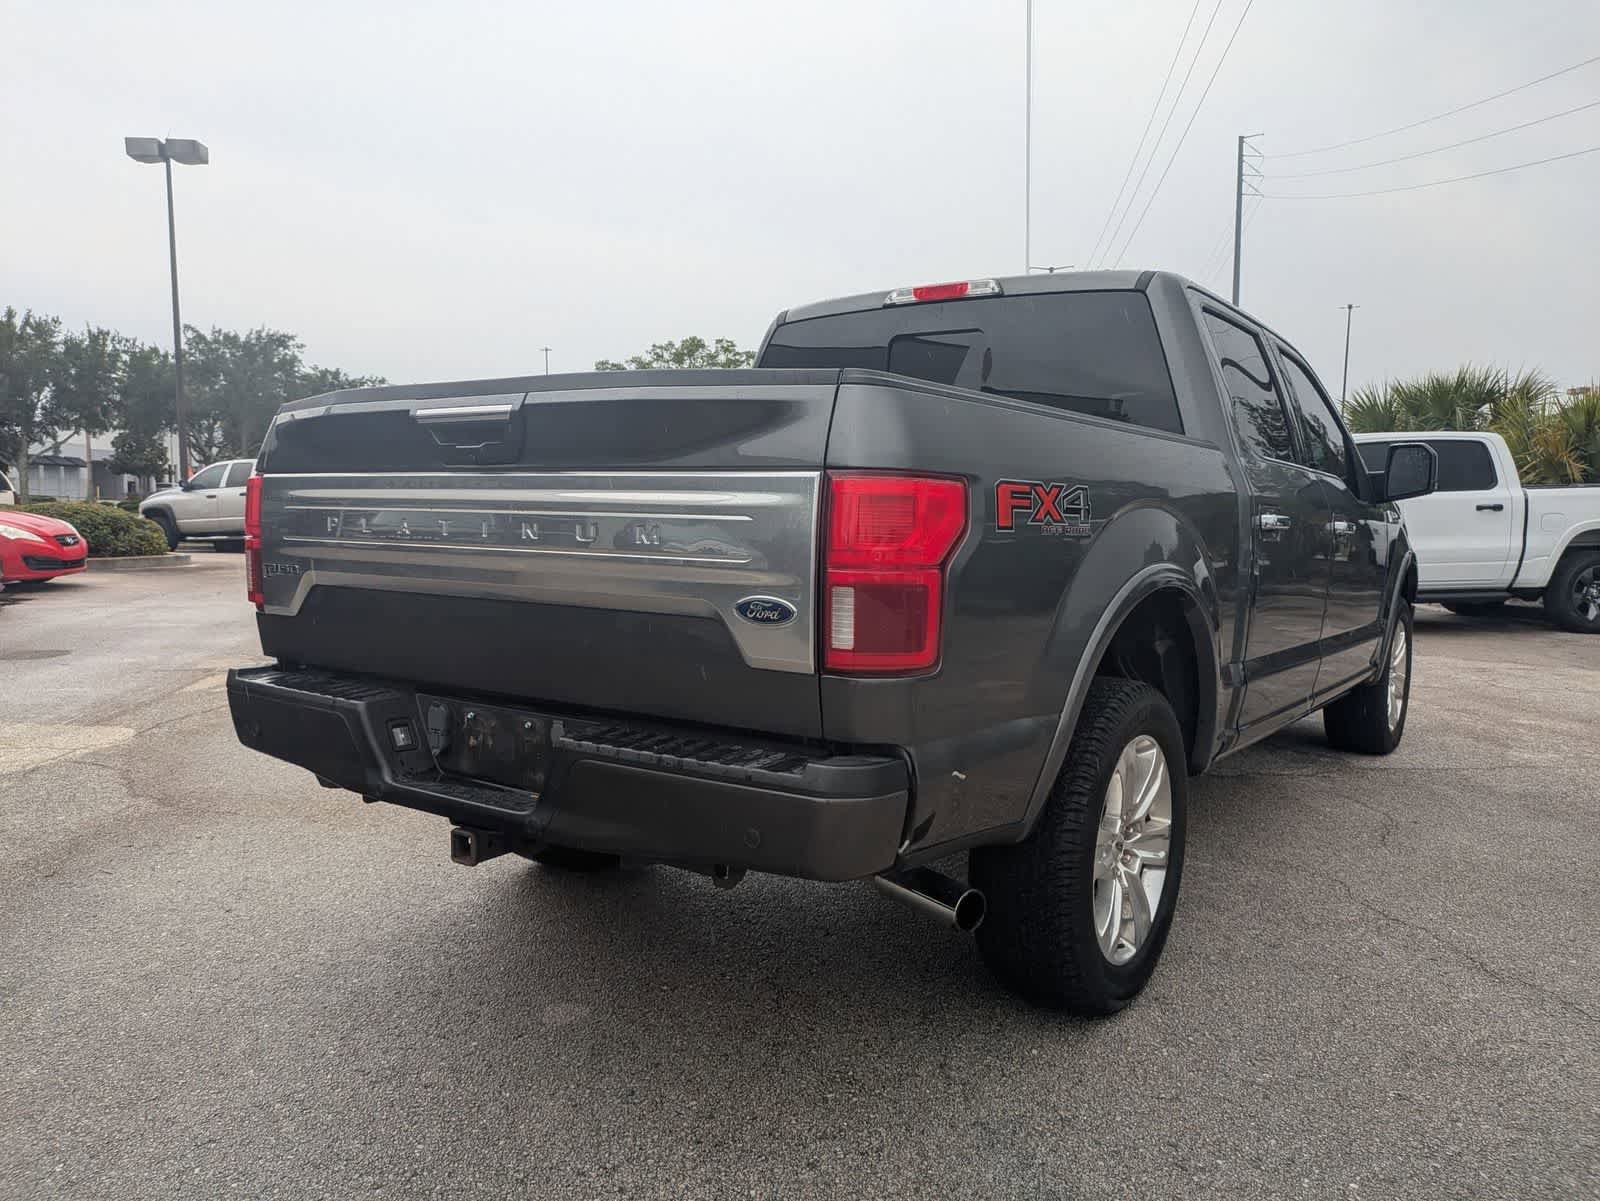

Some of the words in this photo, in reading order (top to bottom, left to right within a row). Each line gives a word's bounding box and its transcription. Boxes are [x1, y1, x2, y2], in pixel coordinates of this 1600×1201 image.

[995, 478, 1092, 533] FX4
[325, 515, 662, 545] PLATINUM
[746, 600, 781, 620] Ford
